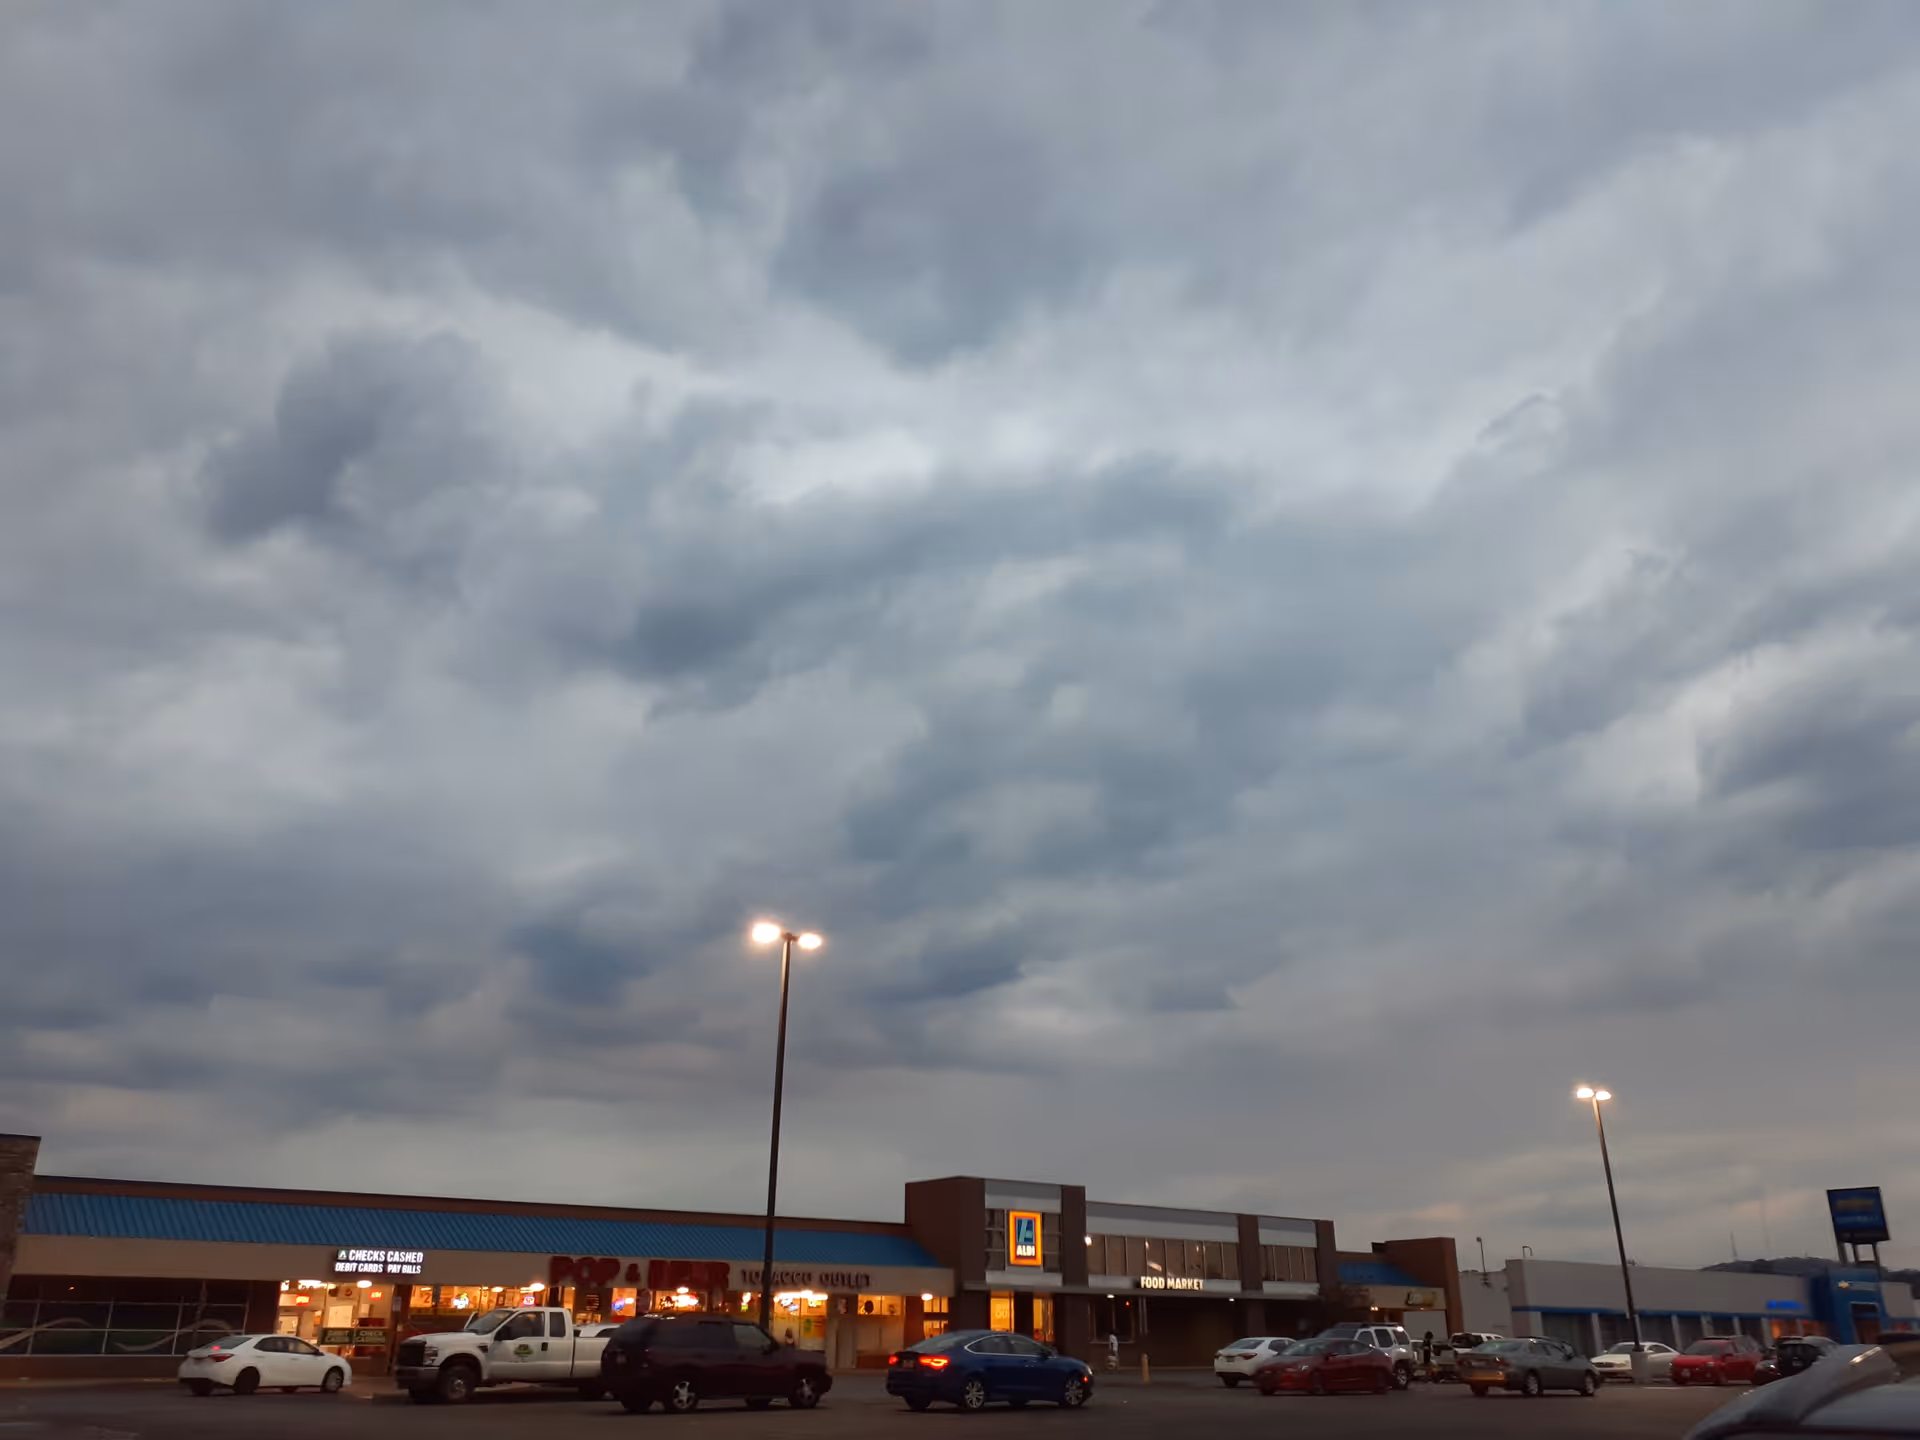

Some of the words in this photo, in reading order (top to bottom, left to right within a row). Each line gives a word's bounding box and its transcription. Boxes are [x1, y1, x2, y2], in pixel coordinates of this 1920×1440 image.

[349, 1249, 385, 1262] CHECKS
[387, 1251, 423, 1263] CASHED
[1016, 1245, 1035, 1257] ALDI
[334, 1262, 358, 1272] DEBIT
[358, 1263, 383, 1273] CARDS
[387, 1264, 402, 1273] PAY
[401, 1264, 421, 1274] BILLS
[549, 1256, 620, 1287] POP
[741, 1270, 812, 1286] TOACCO
[819, 1272, 870, 1288] OUTLET
[1140, 1276, 1165, 1289] FOOD
[1167, 1278, 1203, 1290] MARKET
